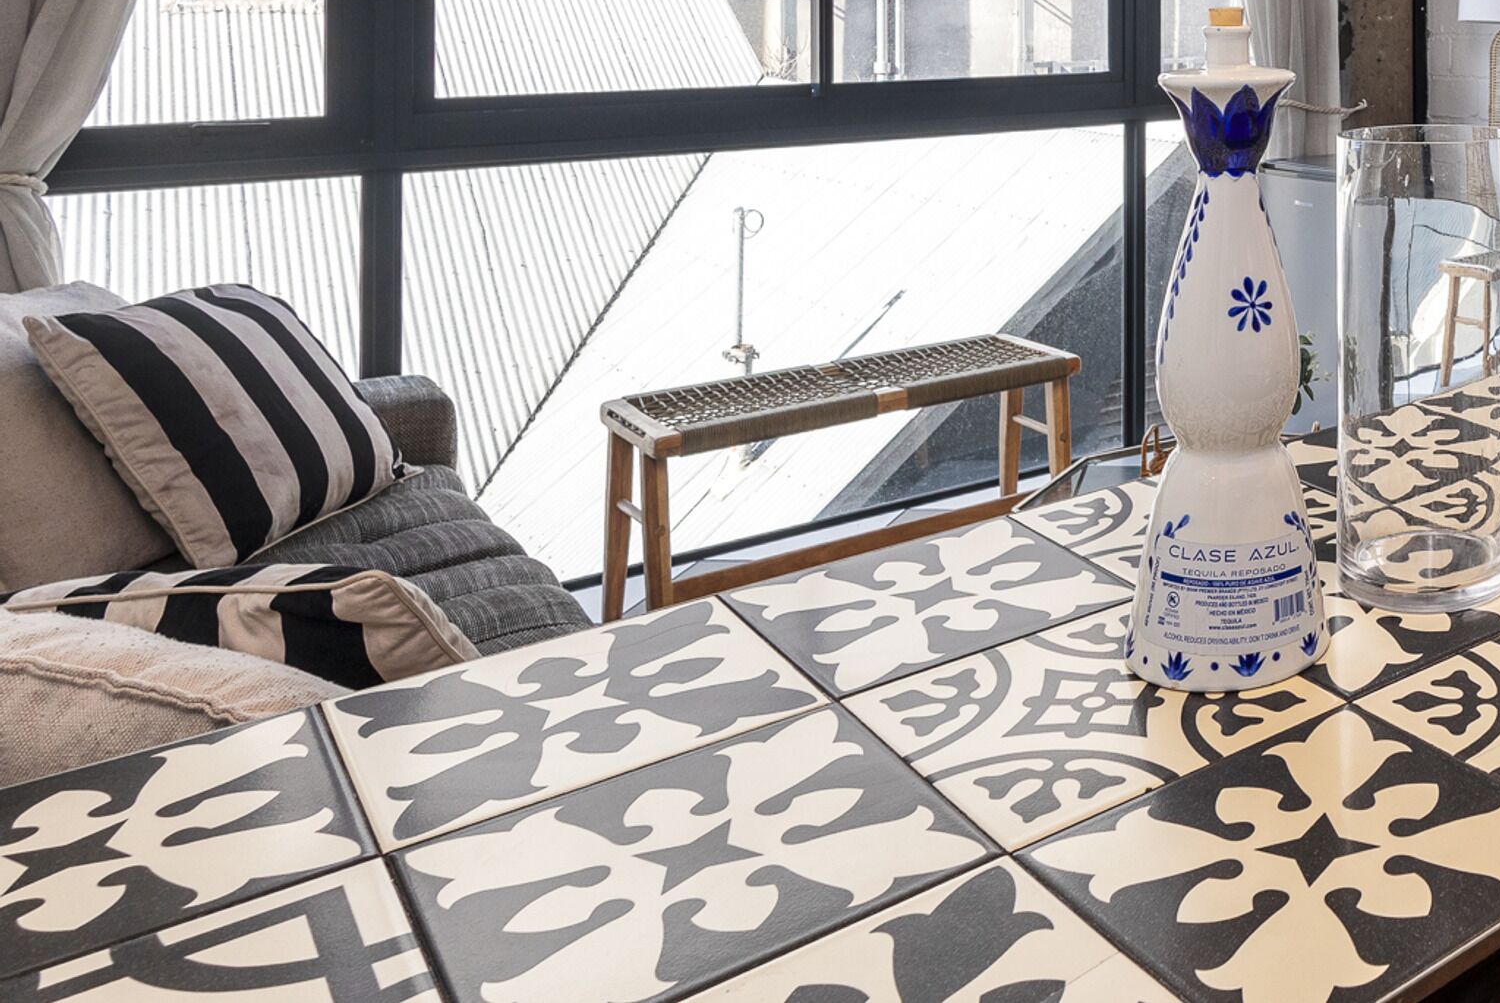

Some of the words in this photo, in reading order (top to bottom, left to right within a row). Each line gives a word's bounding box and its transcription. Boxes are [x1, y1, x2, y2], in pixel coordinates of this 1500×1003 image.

[1168, 544, 1237, 563] CLASE
[1248, 541, 1297, 561] AZUL
[1182, 567, 1227, 578] TEQUILA
[1230, 563, 1286, 577] REPOSADO
[1184, 635, 1207, 645] REDUCES
